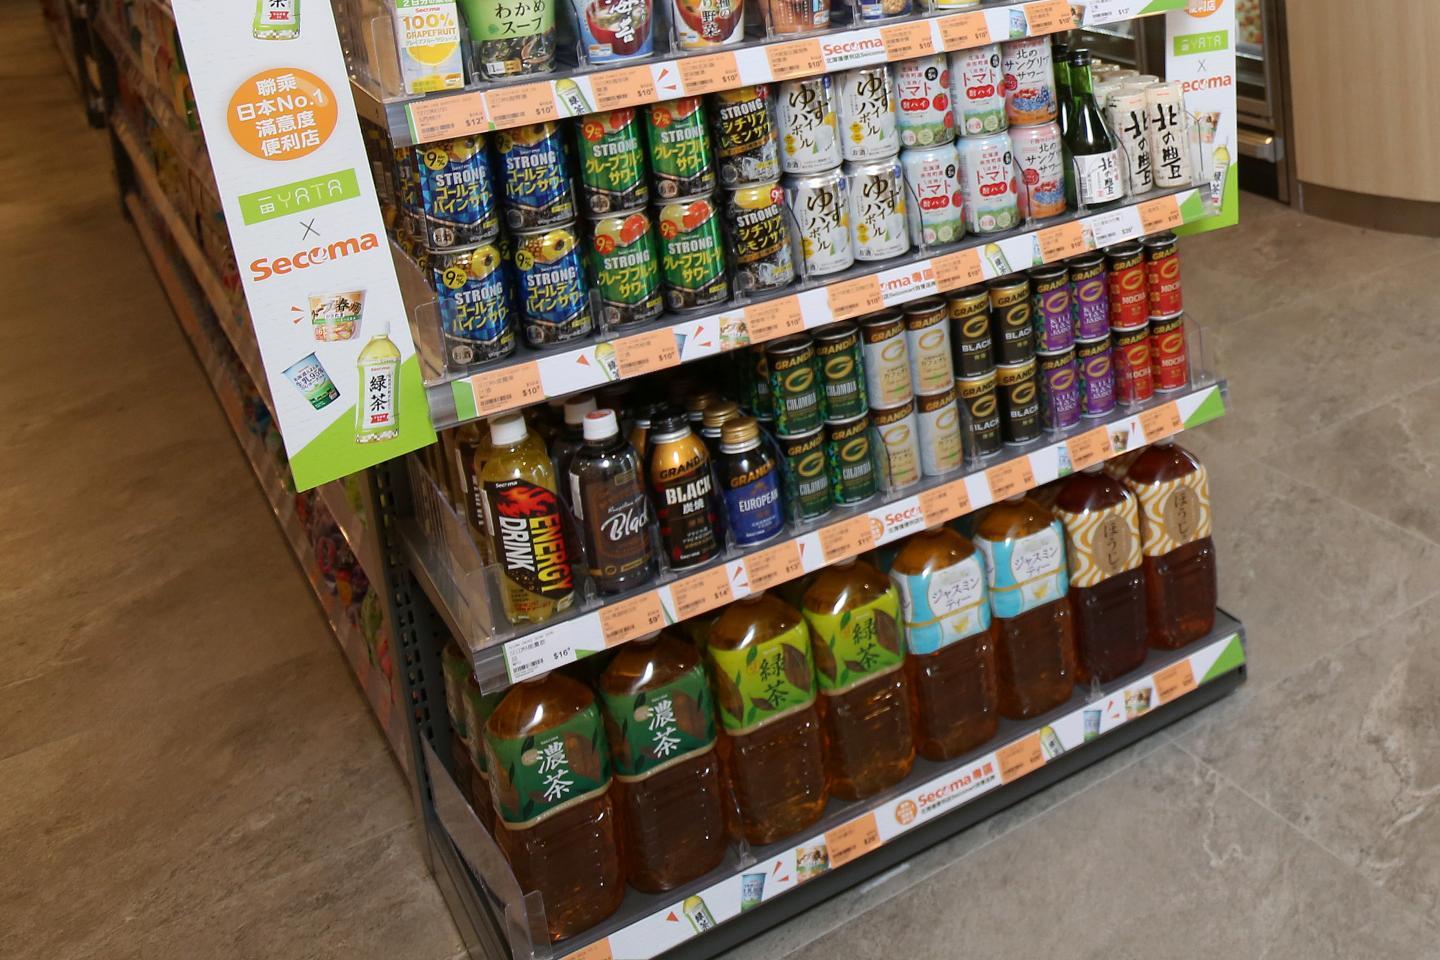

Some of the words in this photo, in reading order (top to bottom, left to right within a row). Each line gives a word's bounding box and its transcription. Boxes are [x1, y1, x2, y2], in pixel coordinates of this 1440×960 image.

[403, 14, 454, 31] 100%
[406, 27, 456, 39] GRAPEFRUIT
[502, 17, 542, 35] スープ
[1017, 49, 1037, 58] 北の
[256, 73, 296, 97] 聯乘
[963, 69, 996, 86] トマト
[236, 89, 325, 122] 日本No.1
[720, 99, 763, 120] STRONG
[255, 110, 316, 138] 滿意度
[660, 125, 704, 144] STRONG
[261, 131, 320, 157] 便利店
[593, 137, 637, 158] STRONG
[506, 151, 556, 170] STRONG
[436, 166, 486, 186] STRONG
[976, 167, 1008, 184] トマト
[917, 180, 951, 196] トマト
[737, 205, 780, 228] STRONG
[668, 236, 713, 255] STRONG
[250, 233, 379, 282] Secoma
[604, 249, 650, 270] STRONG
[527, 267, 576, 286] STRONG
[454, 282, 503, 304] STRONG
[1005, 328, 1032, 341] BLACK
[961, 339, 992, 353] BLACK
[368, 375, 387, 412] 緑茶
[1010, 405, 1039, 418] BLACK
[665, 479, 711, 505] BLACK
[499, 516, 536, 572] DRINK
[529, 513, 573, 592] ENERGY
[851, 608, 879, 666] 緑茶
[759, 654, 790, 707] 緑茶
[648, 699, 681, 757] 濃茶
[537, 741, 574, 801] 濃茶
